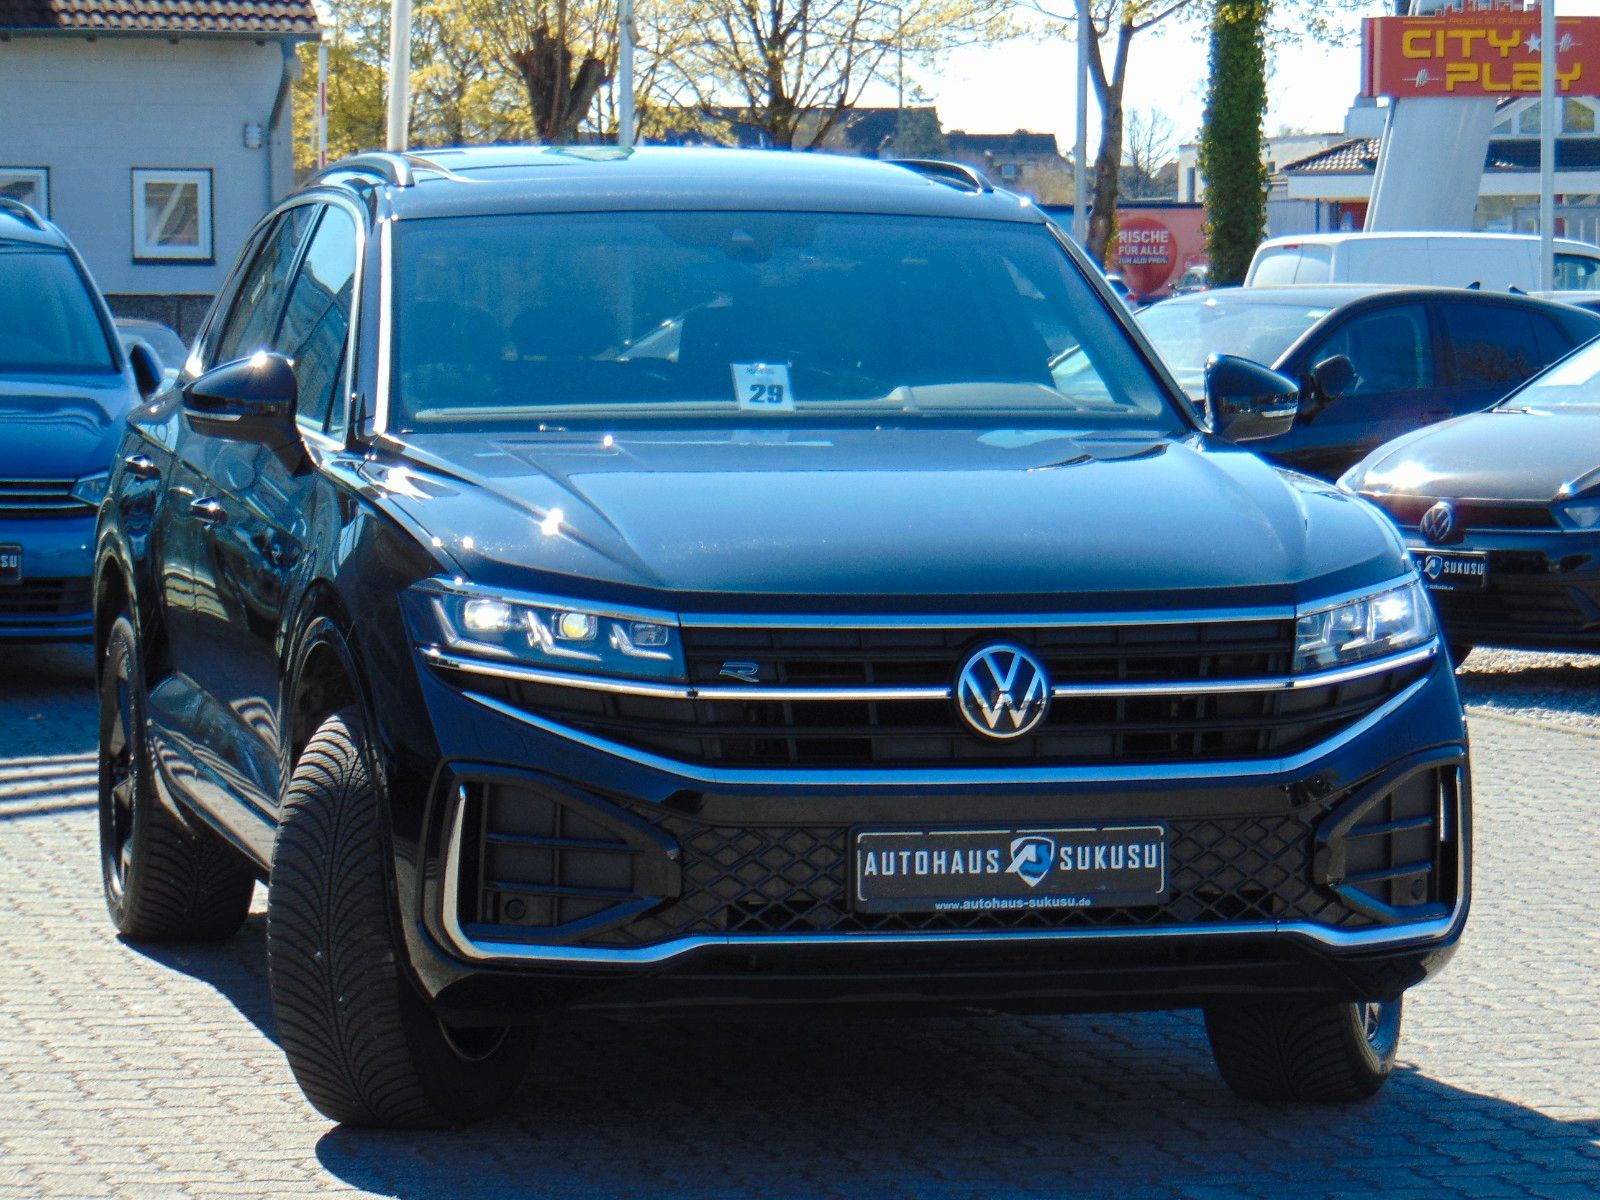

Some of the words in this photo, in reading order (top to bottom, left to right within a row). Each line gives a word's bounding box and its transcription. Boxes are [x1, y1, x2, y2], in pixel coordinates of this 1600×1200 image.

[1402, 29, 1521, 59] CITY
[1119, 230, 1168, 242] RISCHE
[1119, 244, 1138, 255] FÜR
[749, 384, 784, 404] 29
[1443, 561, 1483, 575] SUKUSU
[863, 849, 1000, 876] AUTOHAUS
[1059, 843, 1158, 871] SUKUSU
[934, 897, 1092, 911] www.autohaus-sukusu.de
